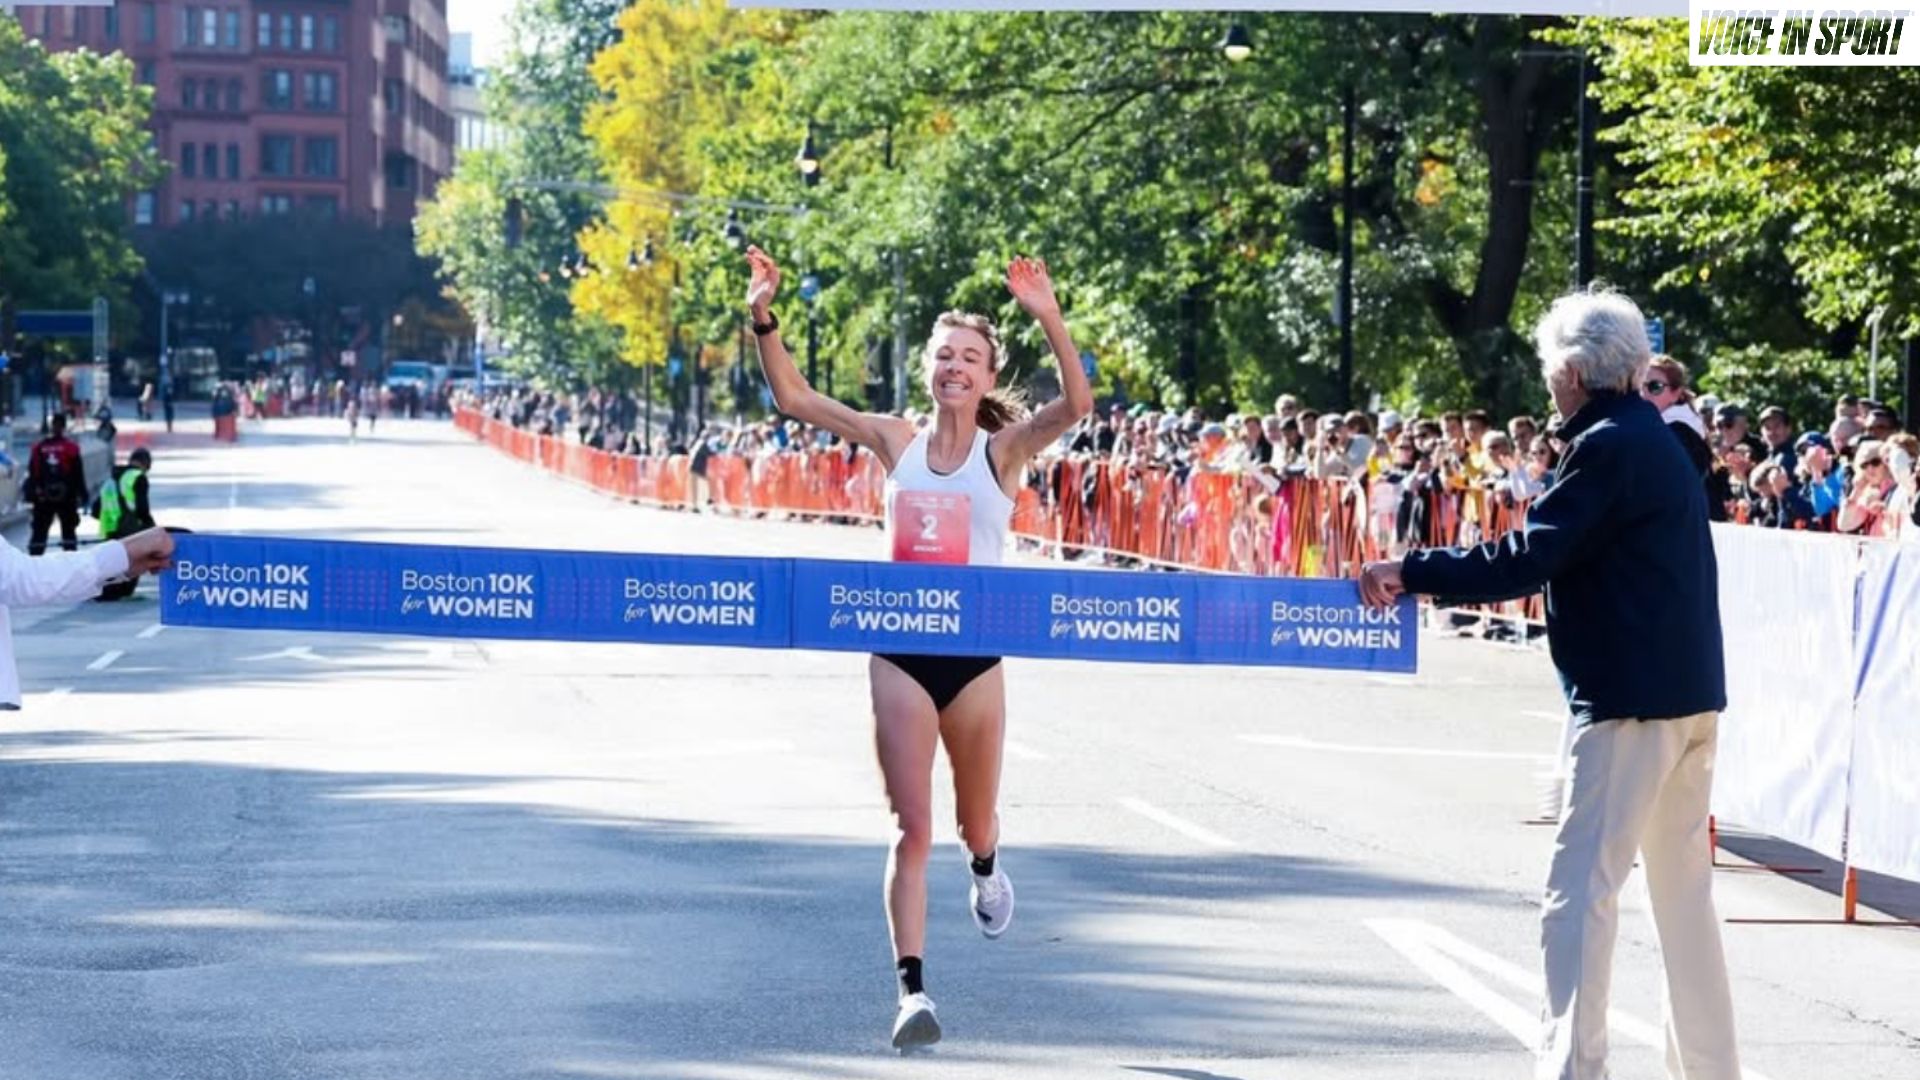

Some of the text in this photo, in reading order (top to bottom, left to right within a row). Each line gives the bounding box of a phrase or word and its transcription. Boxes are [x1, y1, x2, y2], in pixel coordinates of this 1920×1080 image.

[920, 514, 939, 540] 2
[176, 560, 309, 585] Boston 10K
[402, 570, 534, 594] Boston 10K
[176, 584, 309, 610] for WOMEN
[624, 577, 755, 601] Boston 10K
[830, 584, 961, 610] Boston 10K
[401, 594, 534, 618] for WOMEN
[624, 602, 756, 626] for WOMEN
[1050, 593, 1181, 618] Boston 10K
[1271, 601, 1402, 625] Boston 10K
[830, 609, 961, 634] for WOMEN
[1050, 618, 1181, 643] for WOMEN
[1270, 626, 1402, 650] for WOMEN
